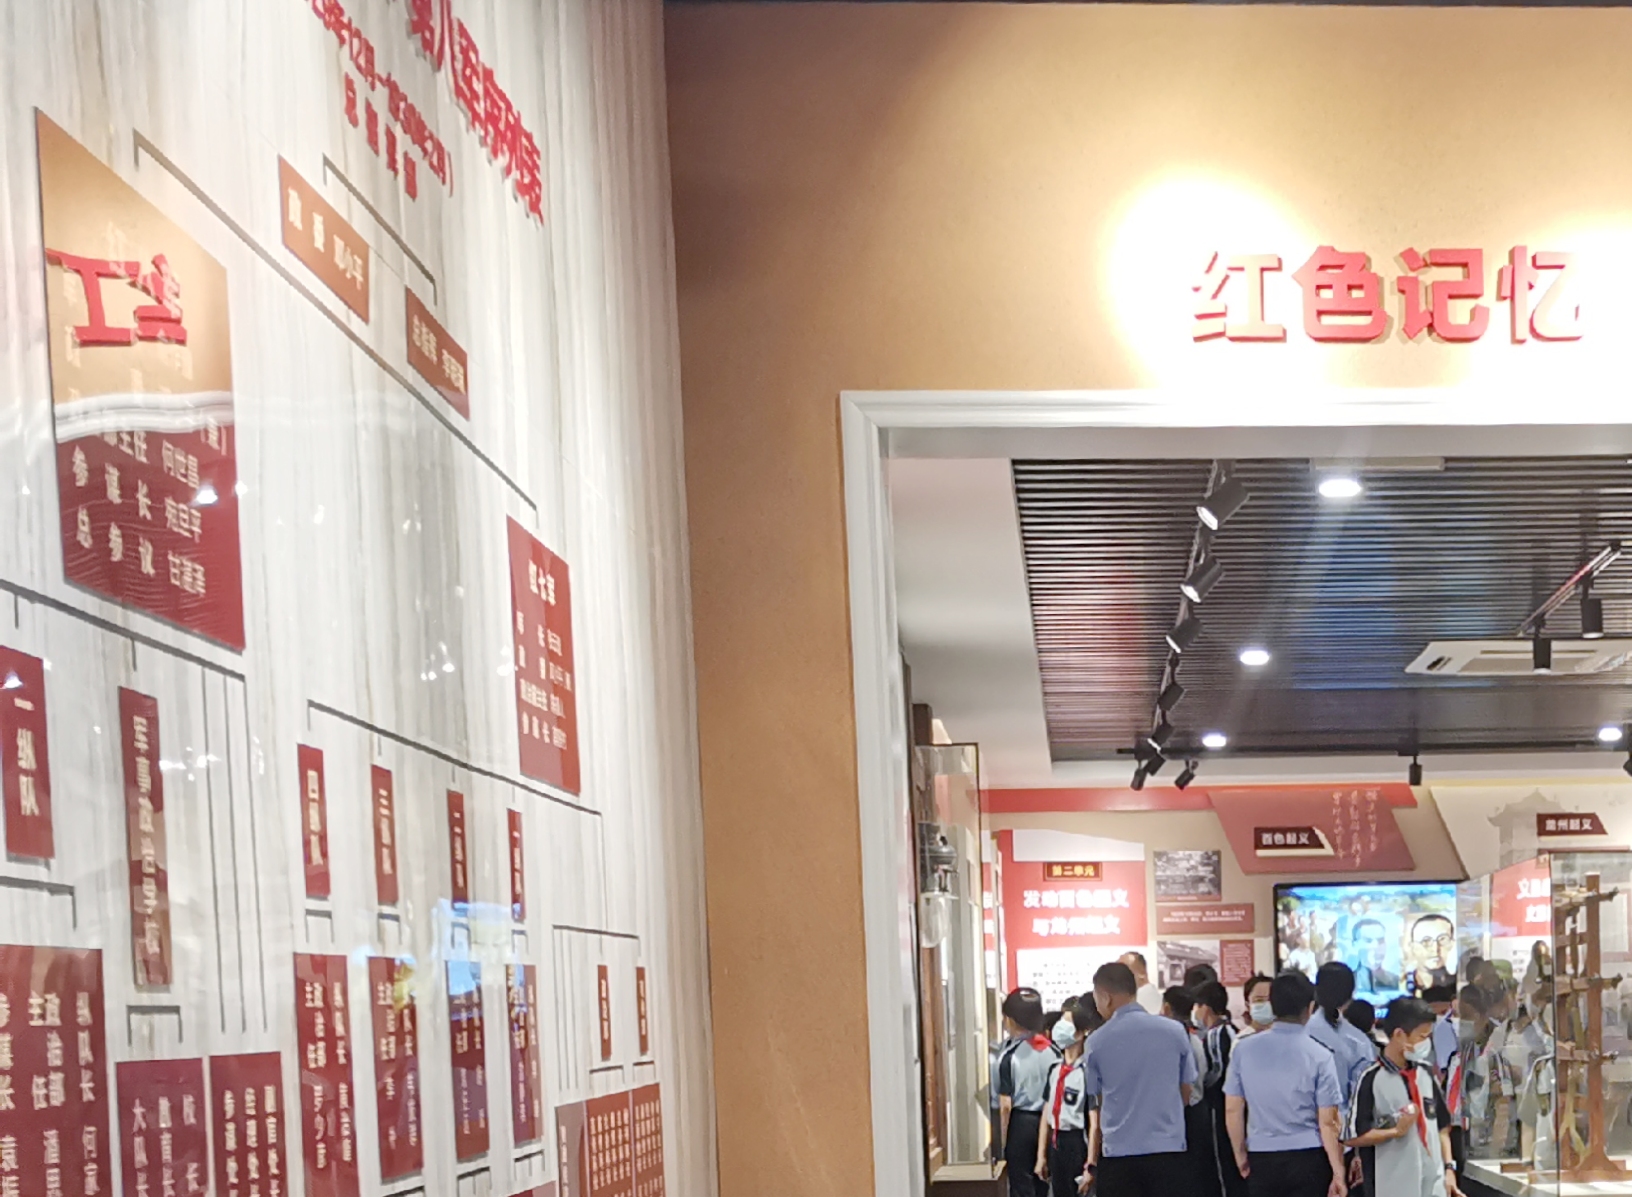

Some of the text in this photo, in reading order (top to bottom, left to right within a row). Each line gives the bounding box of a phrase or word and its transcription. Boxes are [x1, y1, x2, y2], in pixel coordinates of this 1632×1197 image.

[1191, 244, 1584, 343] 红色记忆
[13, 697, 40, 817] 一纵队
[1260, 831, 1311, 846] 百色起义
[1022, 888, 1130, 908] 发动百色起义
